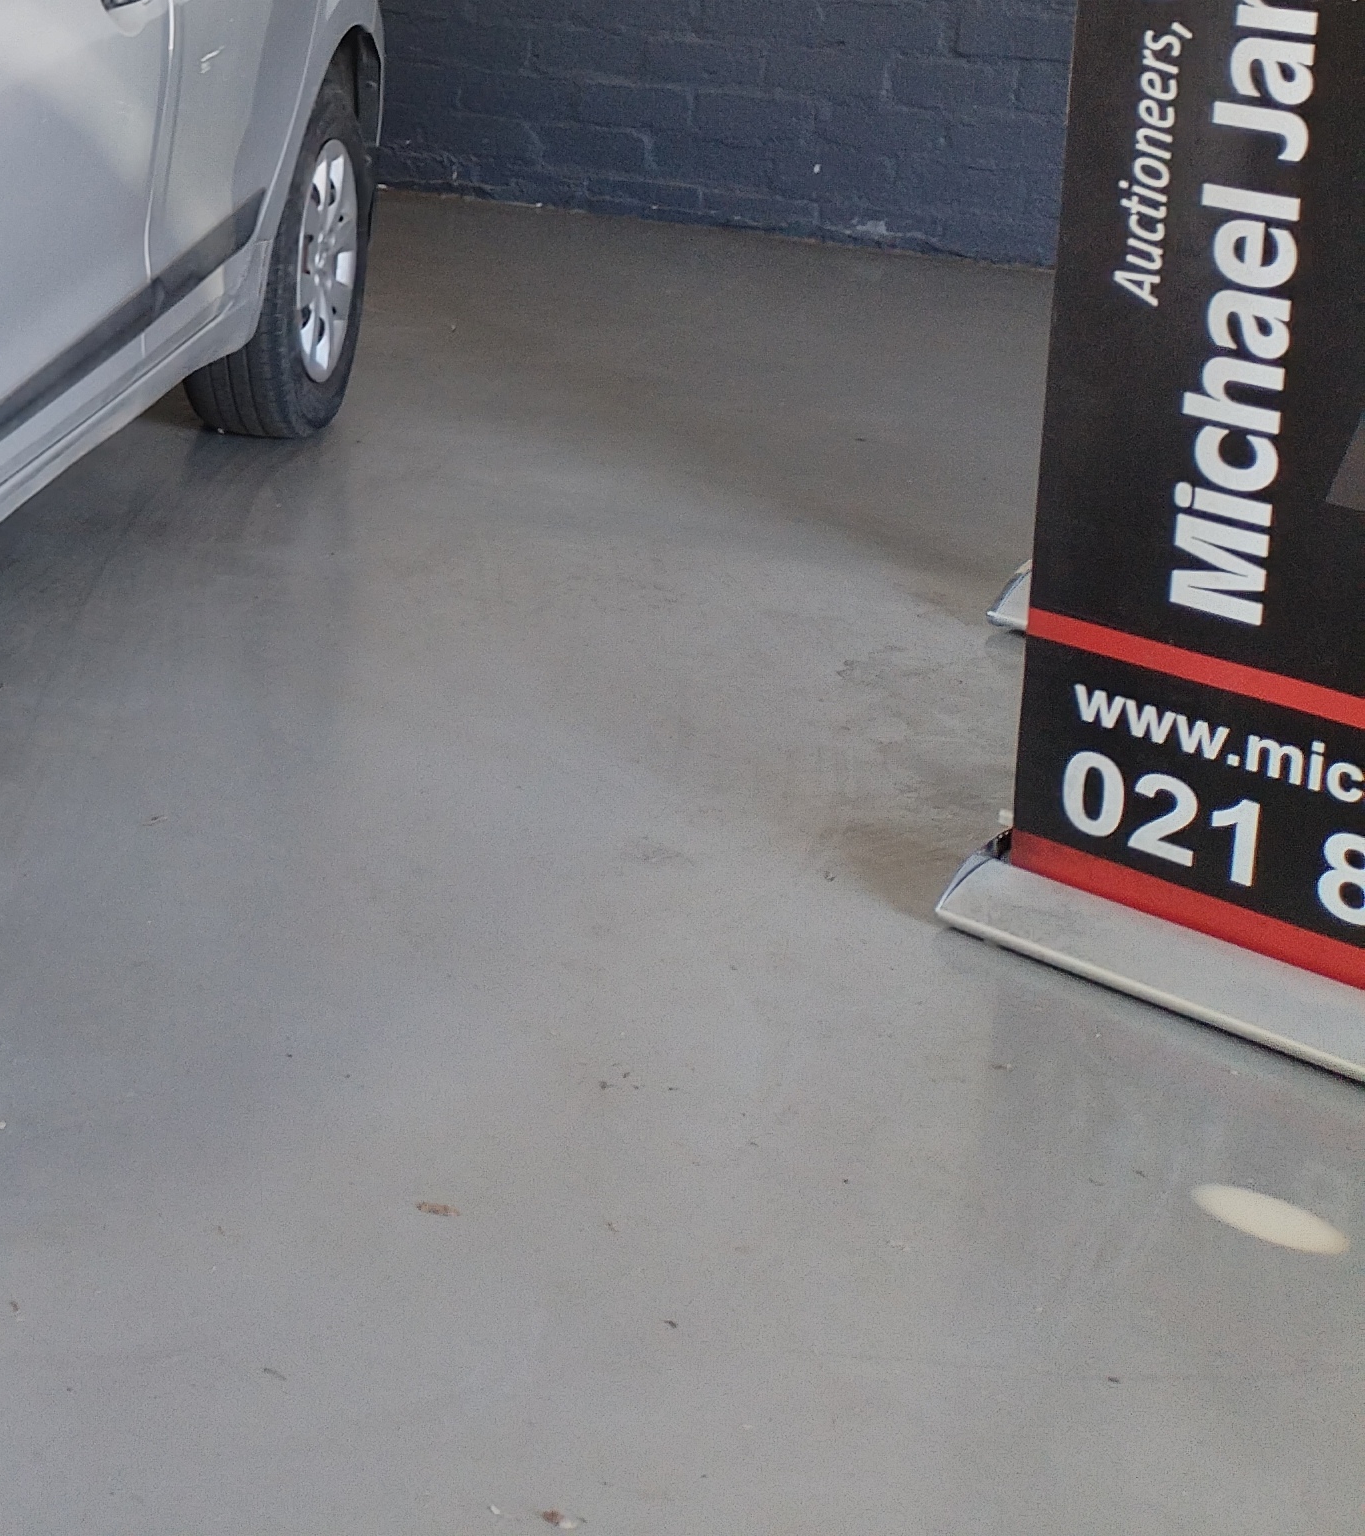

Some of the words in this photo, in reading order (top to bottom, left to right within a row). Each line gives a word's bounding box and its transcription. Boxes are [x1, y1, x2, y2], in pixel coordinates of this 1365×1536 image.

[1112, 18, 1191, 309] Auctioneers,
[1169, 179, 1303, 628] Michael
[1062, 751, 1262, 887] 021
